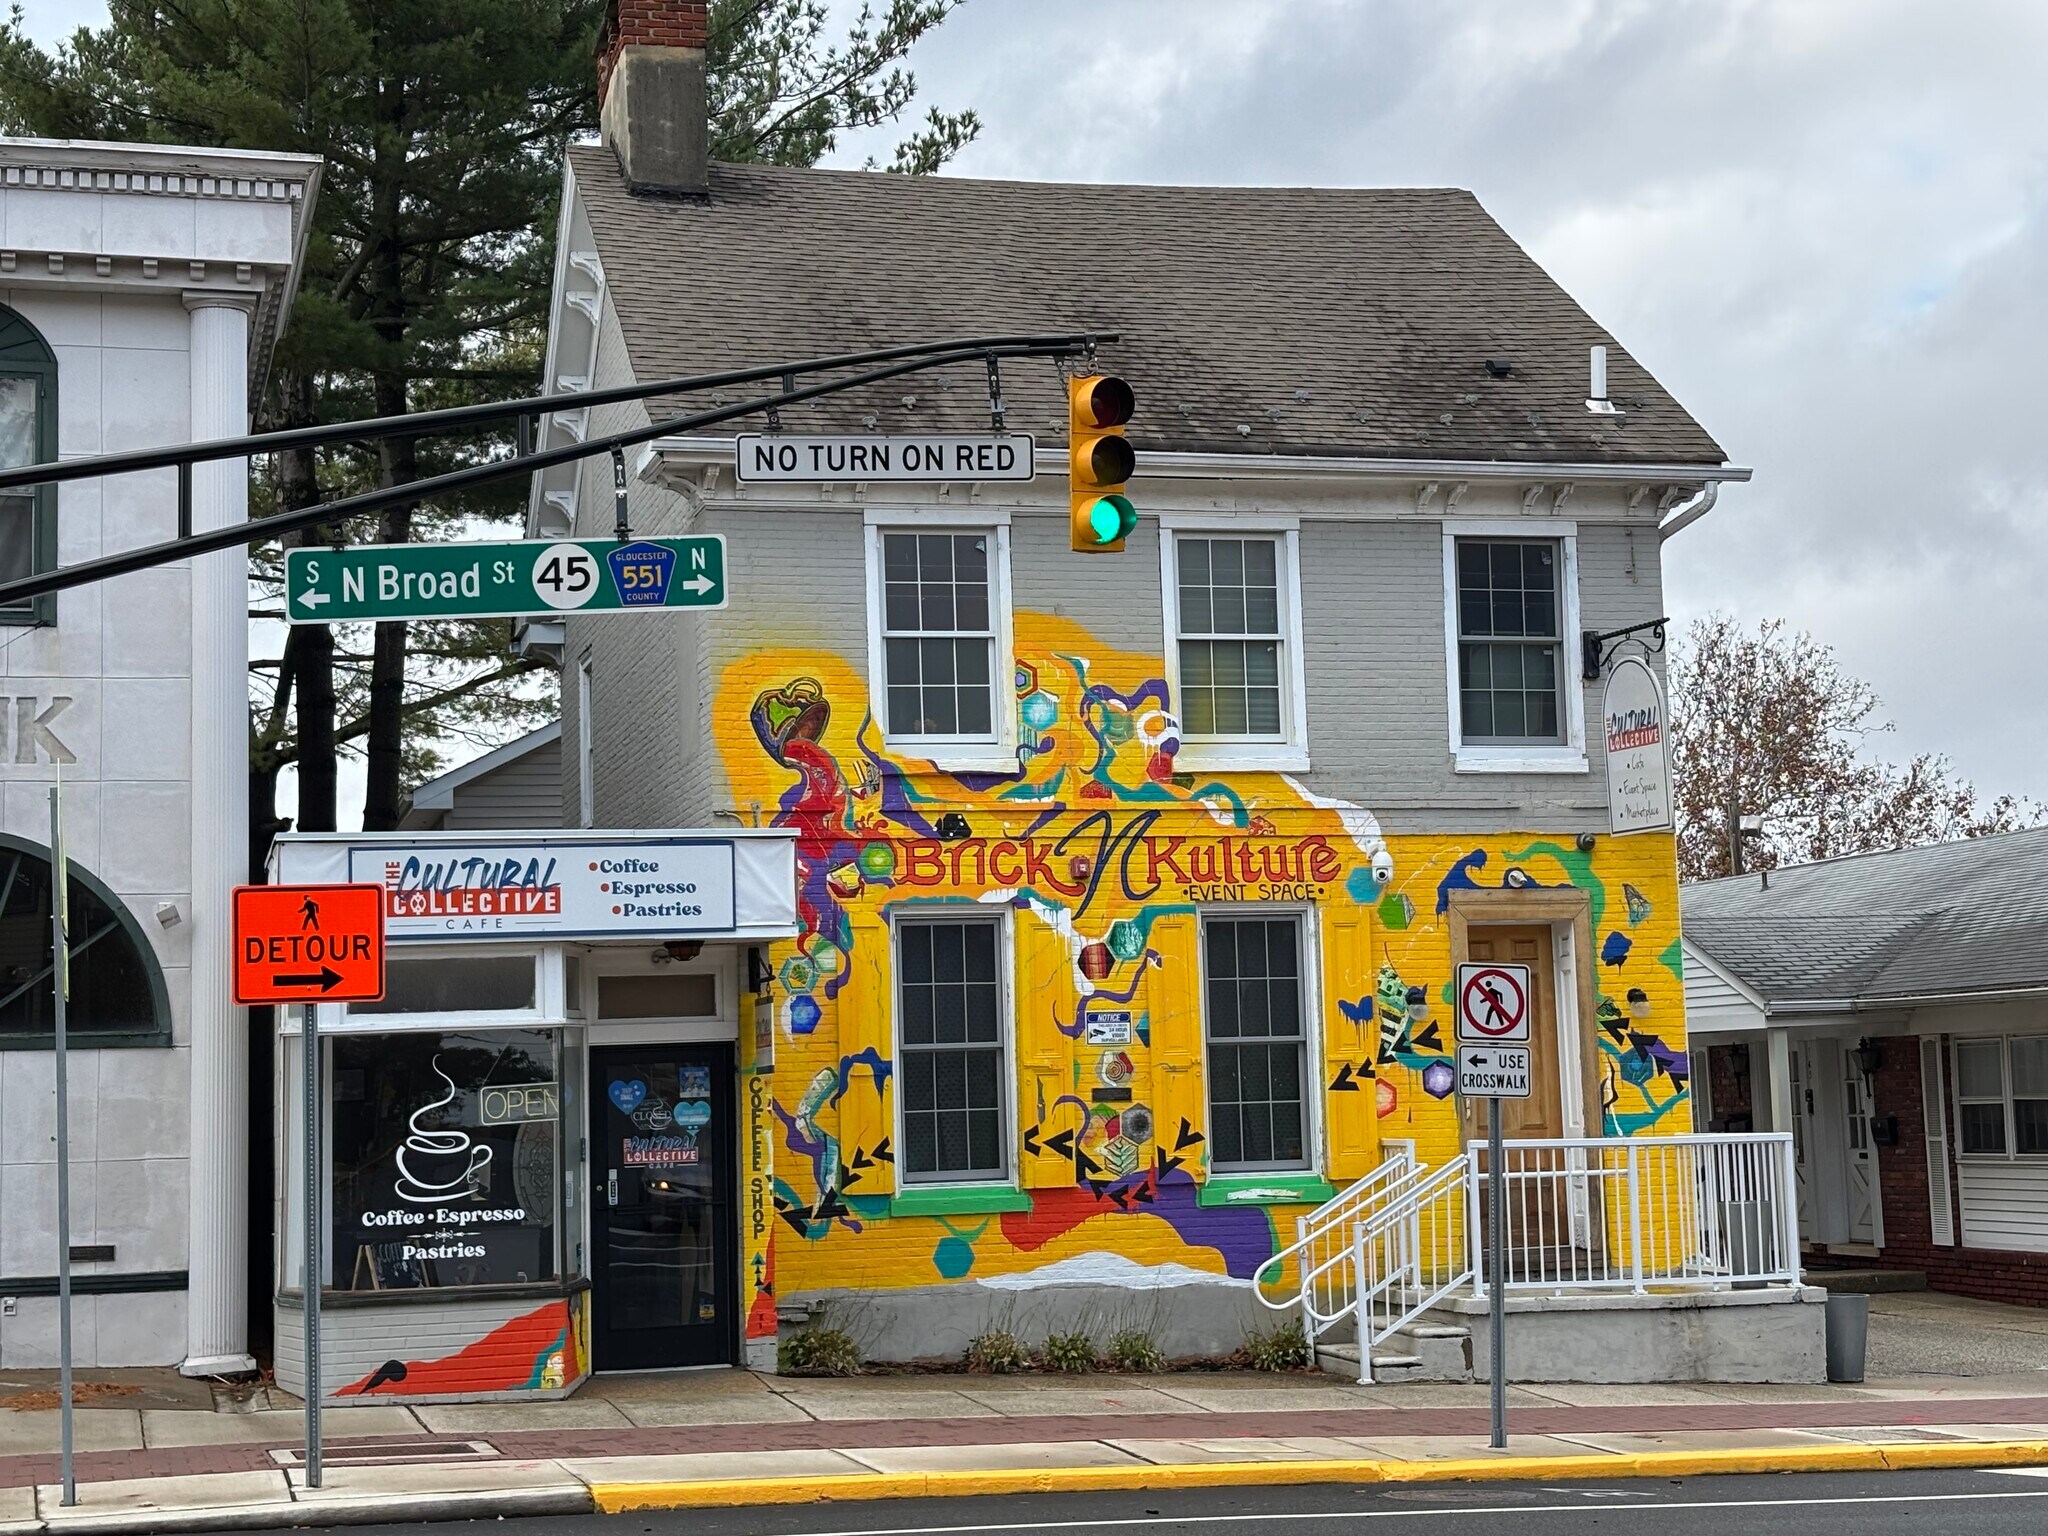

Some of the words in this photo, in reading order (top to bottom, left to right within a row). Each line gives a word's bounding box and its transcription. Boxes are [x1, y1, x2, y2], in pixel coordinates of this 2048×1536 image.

[755, 445, 798, 471] NO
[808, 445, 890, 471] TURN
[902, 445, 944, 471] ON
[956, 445, 1015, 470] RED
[615, 552, 668, 561] GLOUCESTER
[692, 548, 706, 570] N
[306, 560, 320, 584] S
[342, 566, 365, 602] N
[378, 561, 480, 601] Broad
[493, 561, 515, 584] St
[537, 556, 591, 592] 45
[623, 565, 662, 589] 551
[626, 592, 659, 601] COUNTY
[0, 696, 77, 764] K
[1610, 706, 1659, 735] CULTURAL
[1609, 728, 1660, 751] COLLECTIVE
[1623, 778, 1640, 795] Event
[1640, 777, 1657, 799] Space
[1624, 800, 1659, 823] Marketplace
[600, 858, 660, 875] Coffee
[898, 838, 1086, 898] Brick
[1145, 835, 1342, 884] Kulture
[386, 861, 400, 888] THE
[397, 856, 562, 902] CULTURAL
[611, 879, 697, 897] Espresso
[393, 891, 556, 915] COLLECTIVE
[1189, 884, 1246, 901] EVENT
[1258, 883, 1316, 901] SPACE
[624, 900, 702, 918] Pastries
[446, 918, 503, 930] CAFE
[245, 934, 372, 965] DETOUR
[1097, 1013, 1121, 1022] NOTICE
[1498, 1054, 1525, 1069] USE
[1462, 1073, 1526, 1089] CROSSWALK
[485, 1088, 559, 1119] OPEN
[749, 1076, 763, 1171] COFFEE
[630, 1136, 697, 1152] CULTURAL
[362, 1210, 425, 1227] Coffee
[436, 1208, 525, 1226] Espresso
[751, 1178, 765, 1240] SHOP
[402, 1242, 486, 1260] Pastries
